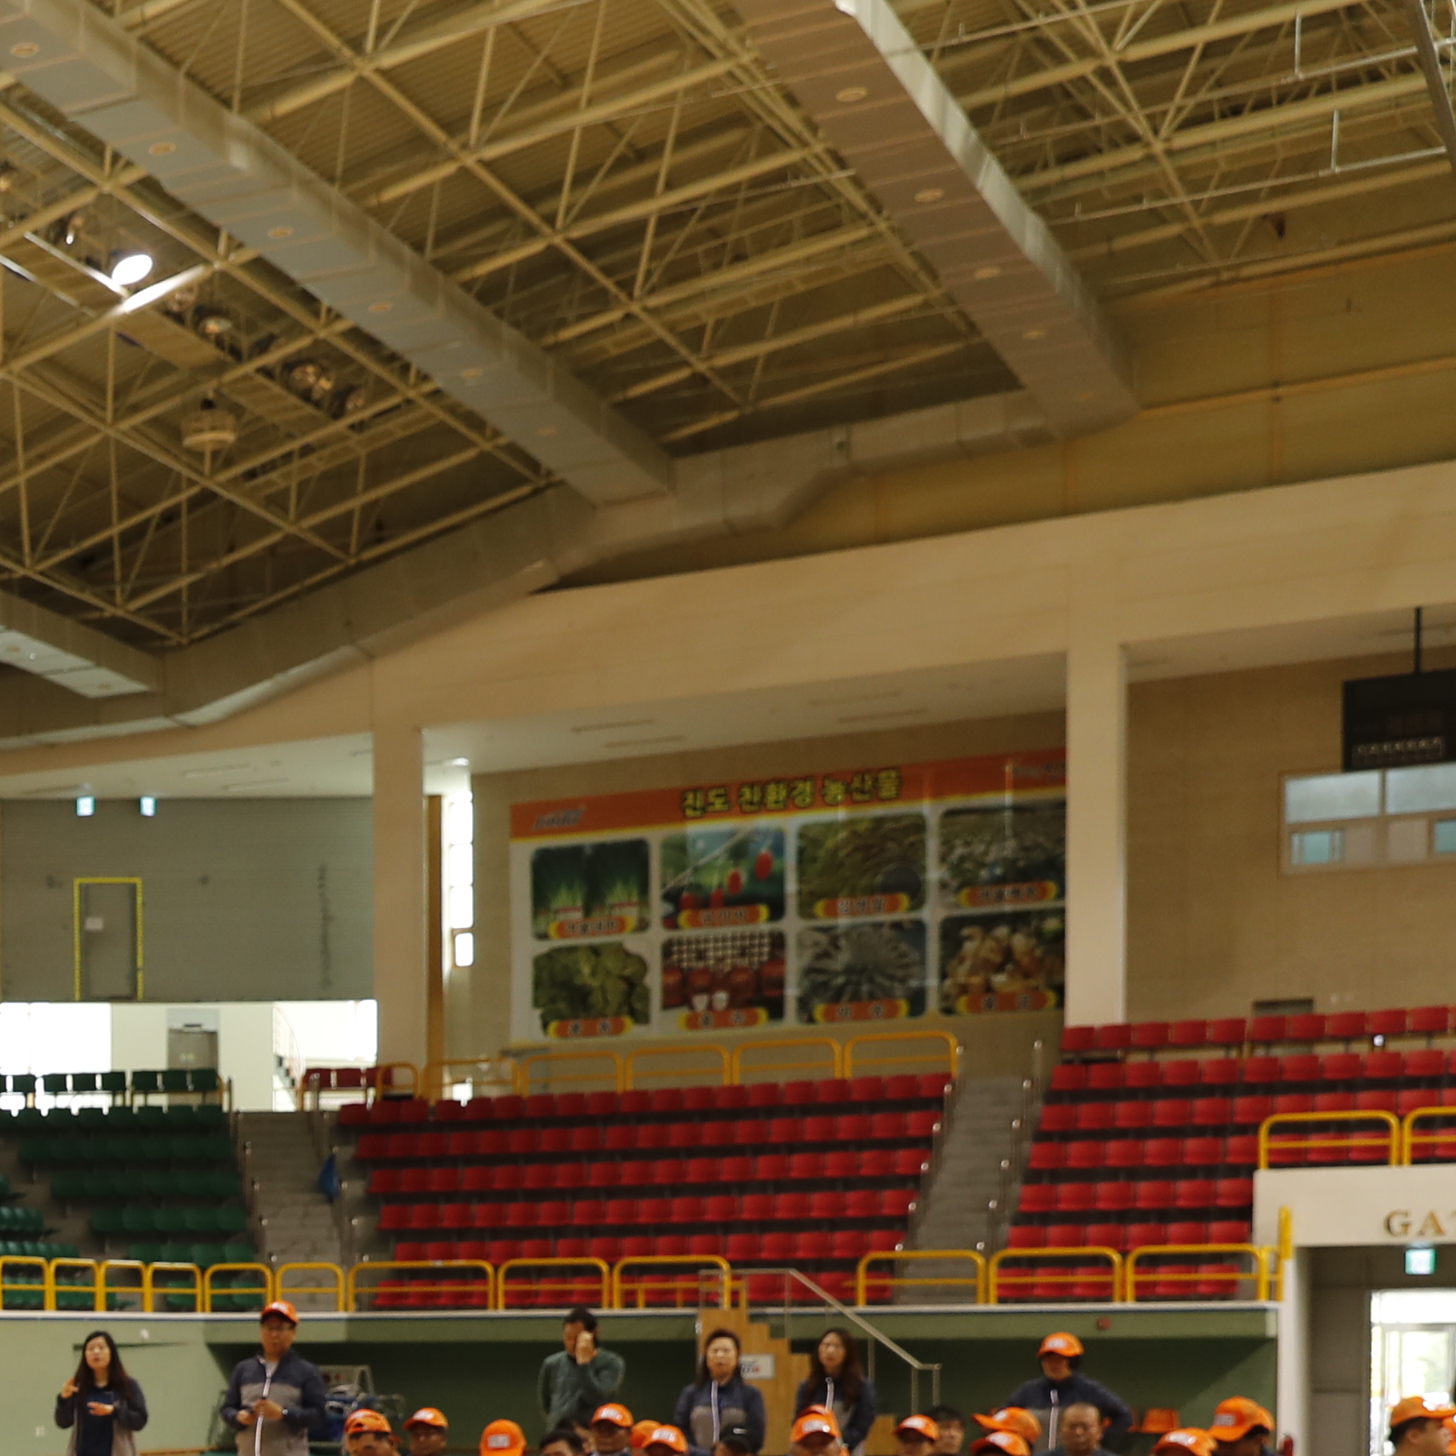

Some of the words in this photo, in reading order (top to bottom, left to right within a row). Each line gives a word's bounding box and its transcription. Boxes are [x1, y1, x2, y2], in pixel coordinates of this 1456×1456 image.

[683, 786, 730, 818] 진도
[738, 779, 814, 815] 친환경
[823, 768, 900, 807] 농산물
